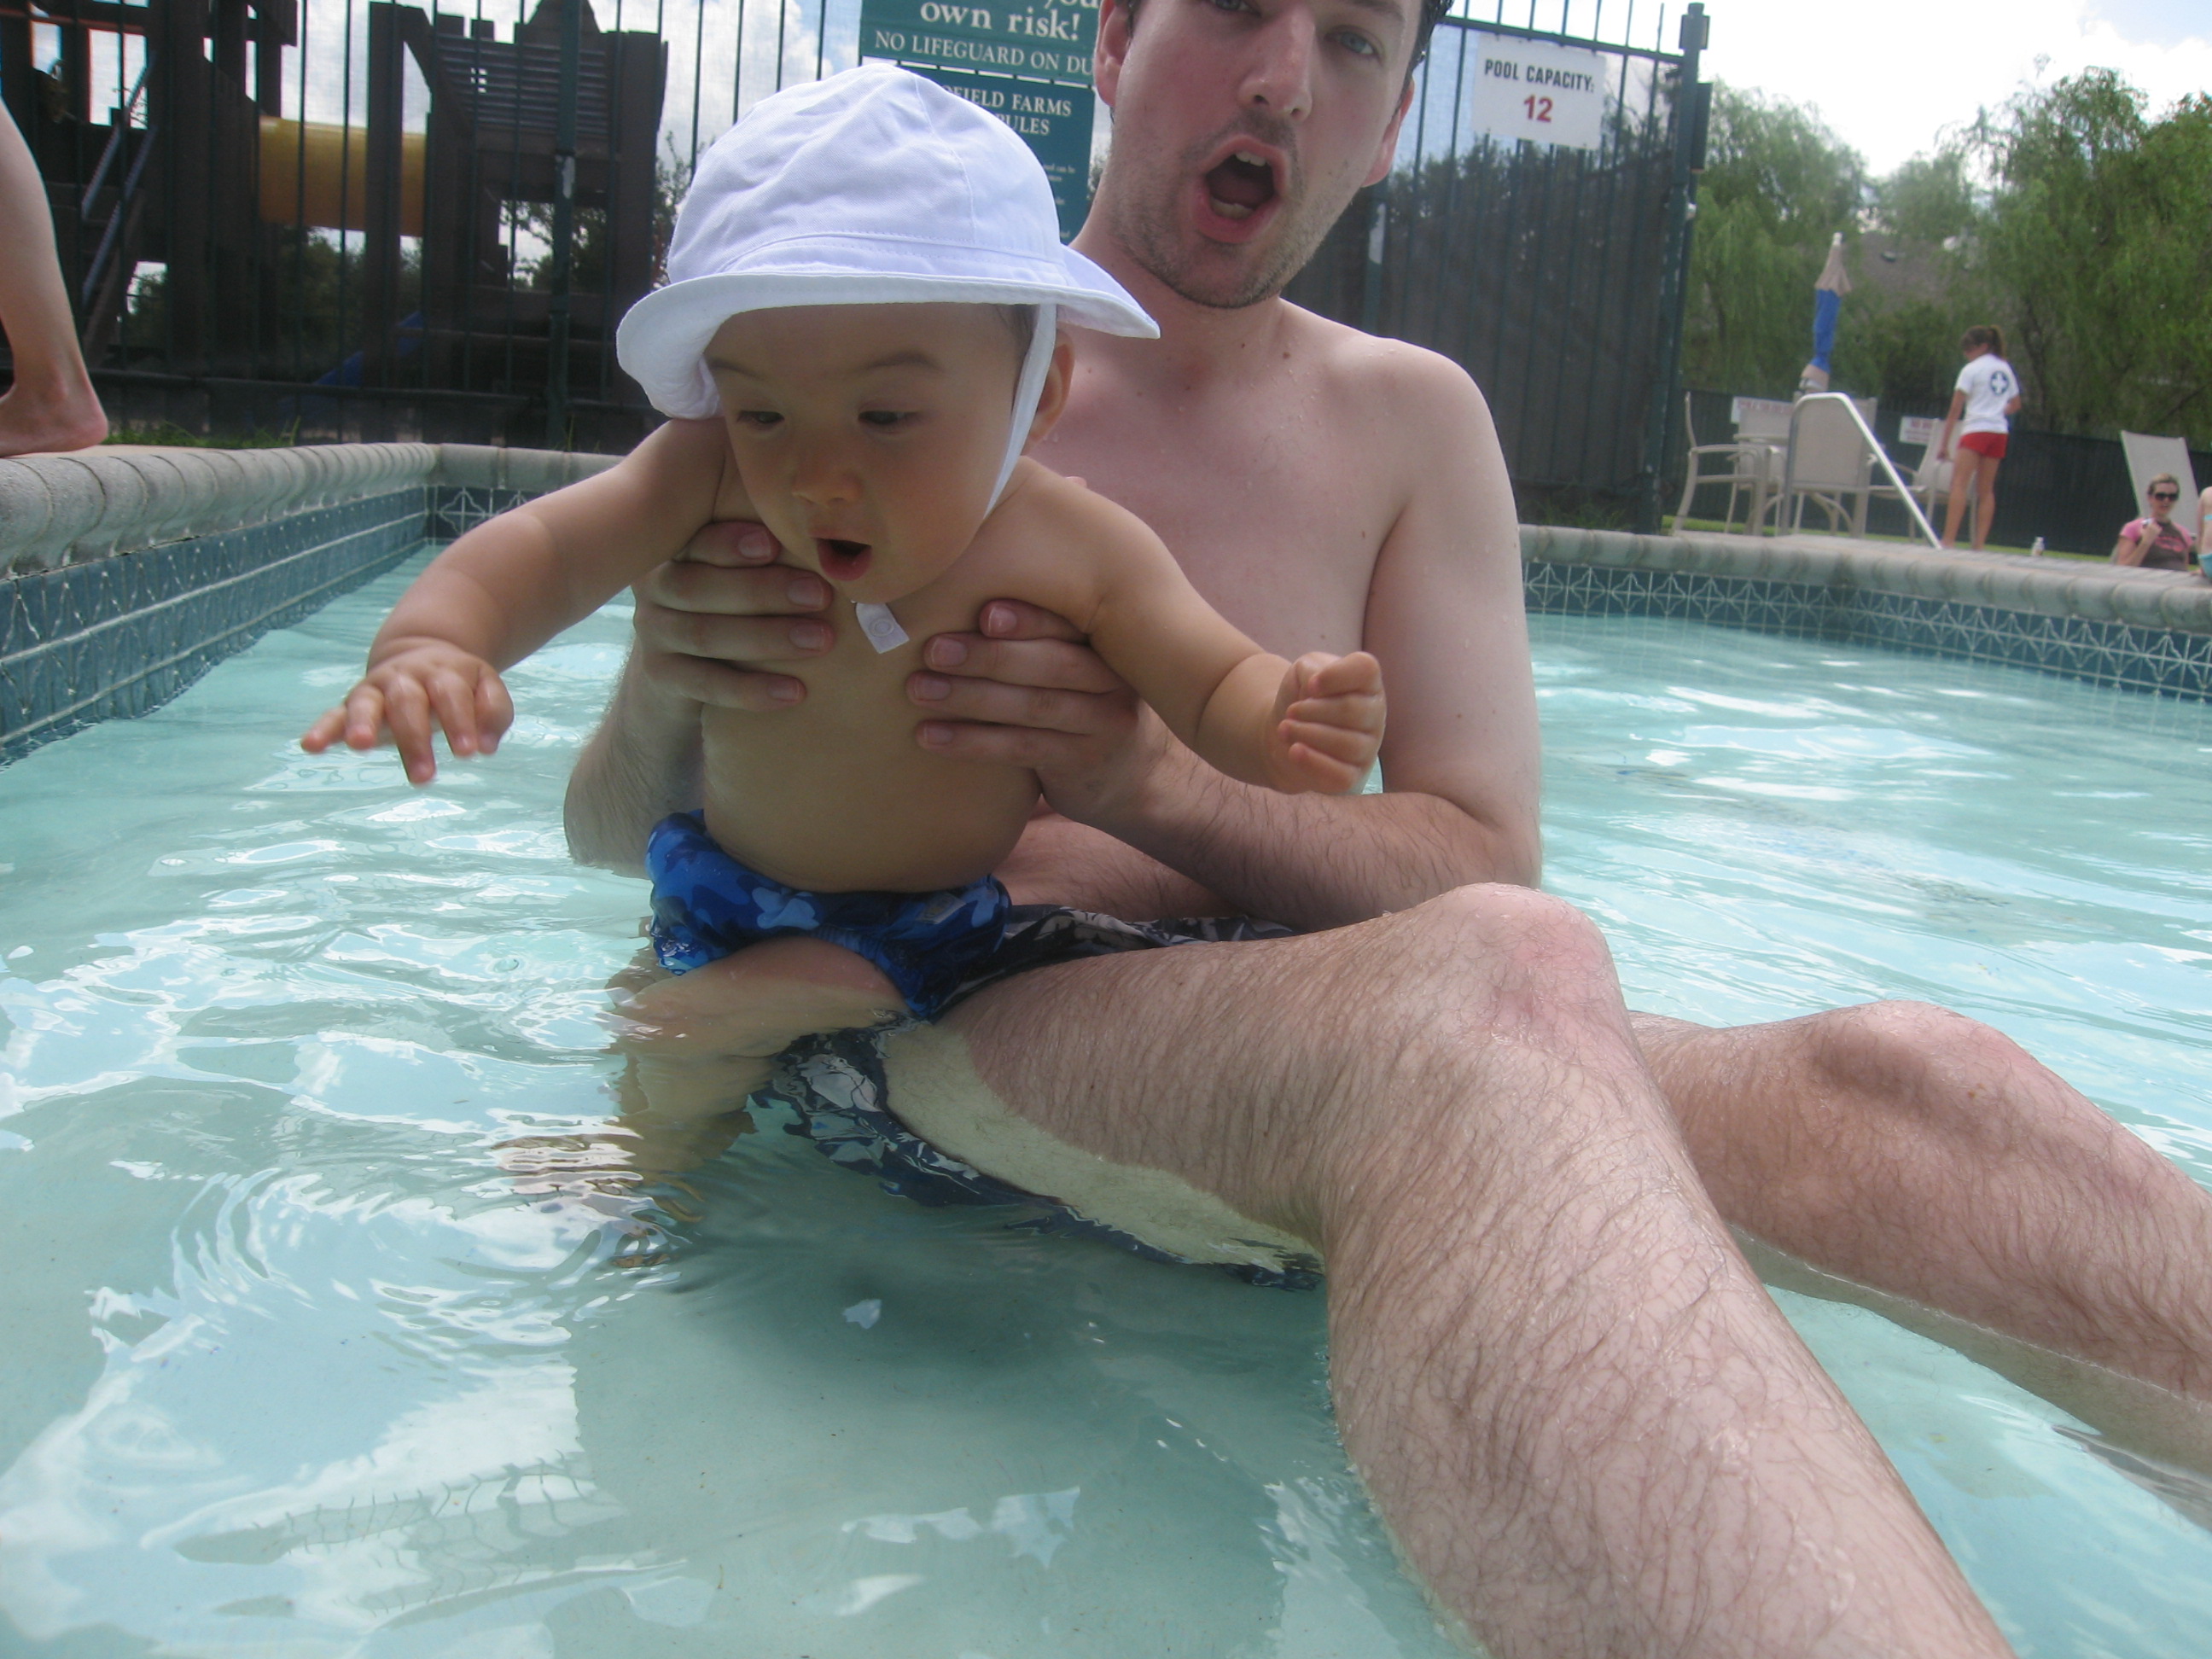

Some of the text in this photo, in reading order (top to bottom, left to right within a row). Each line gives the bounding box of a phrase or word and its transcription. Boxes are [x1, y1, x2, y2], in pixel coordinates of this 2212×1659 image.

[920, 3, 1080, 41] own risk!
[875, 30, 906, 51] NO
[911, 35, 1025, 66] LIFEGUARD
[1030, 50, 1060, 71] ON
[1485, 59, 1594, 93] POOL CAPACITY:
[1012, 93, 1072, 117] FARMS
[1524, 95, 1553, 123] 12
